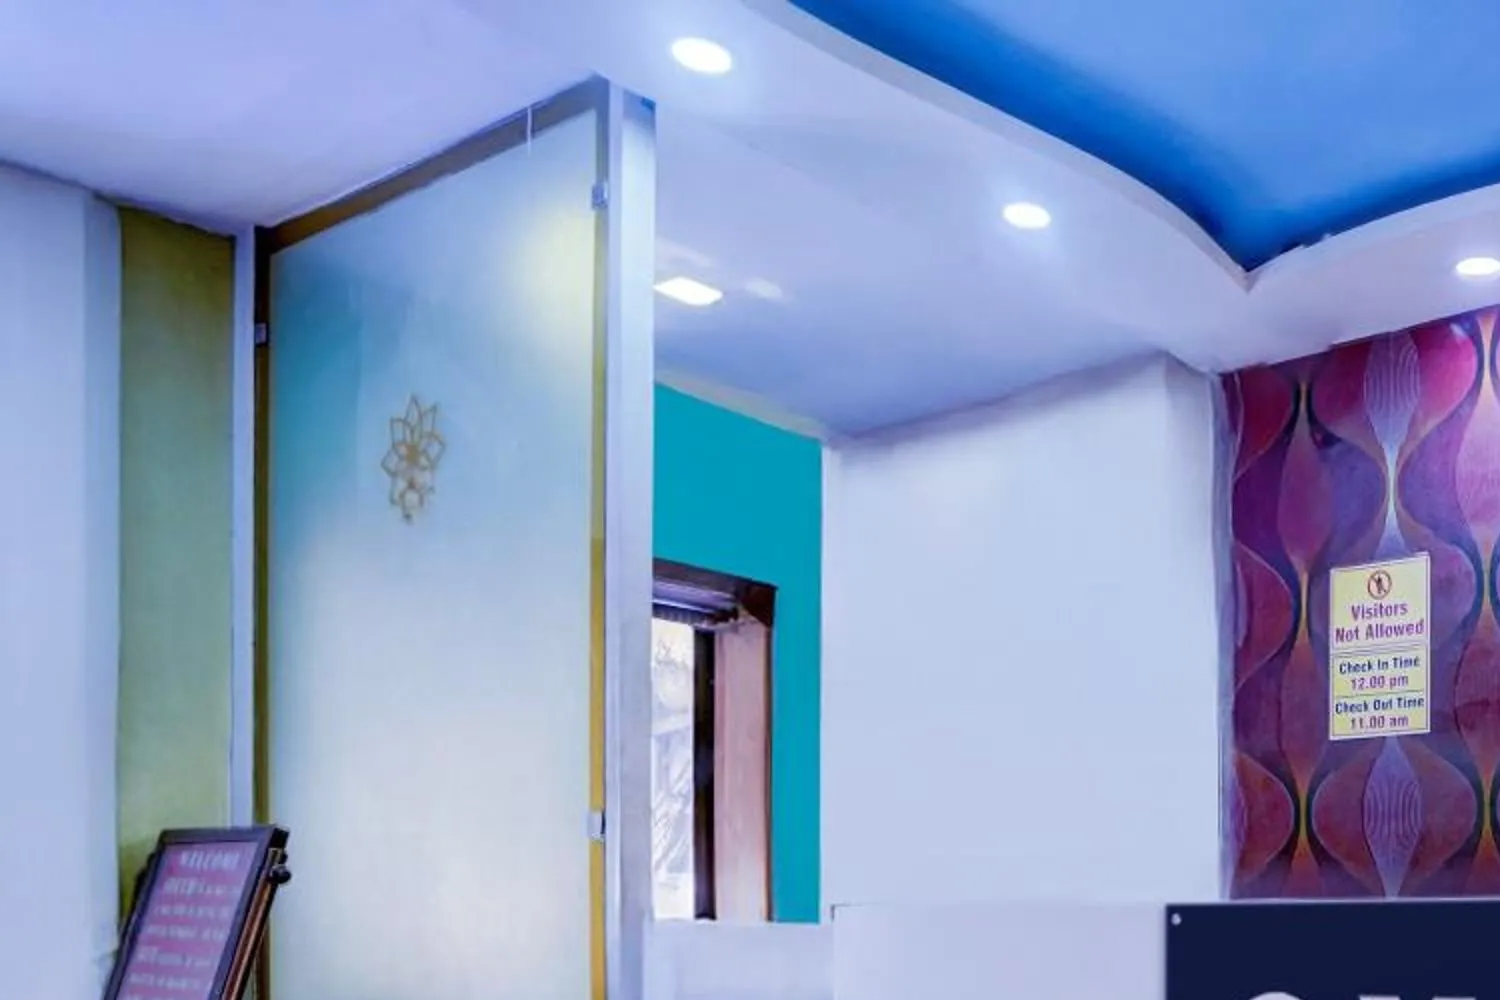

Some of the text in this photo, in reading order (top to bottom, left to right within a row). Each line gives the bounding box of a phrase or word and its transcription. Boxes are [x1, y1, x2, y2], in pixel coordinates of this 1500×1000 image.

[1351, 601, 1409, 621] Visitors
[1335, 618, 1424, 643] Not Allowed
[1339, 655, 1420, 675] Check In Time
[1350, 674, 1409, 691] 12.00 pm
[1335, 696, 1425, 715] Check Out Time
[1350, 715, 1409, 730] 11.00 am
